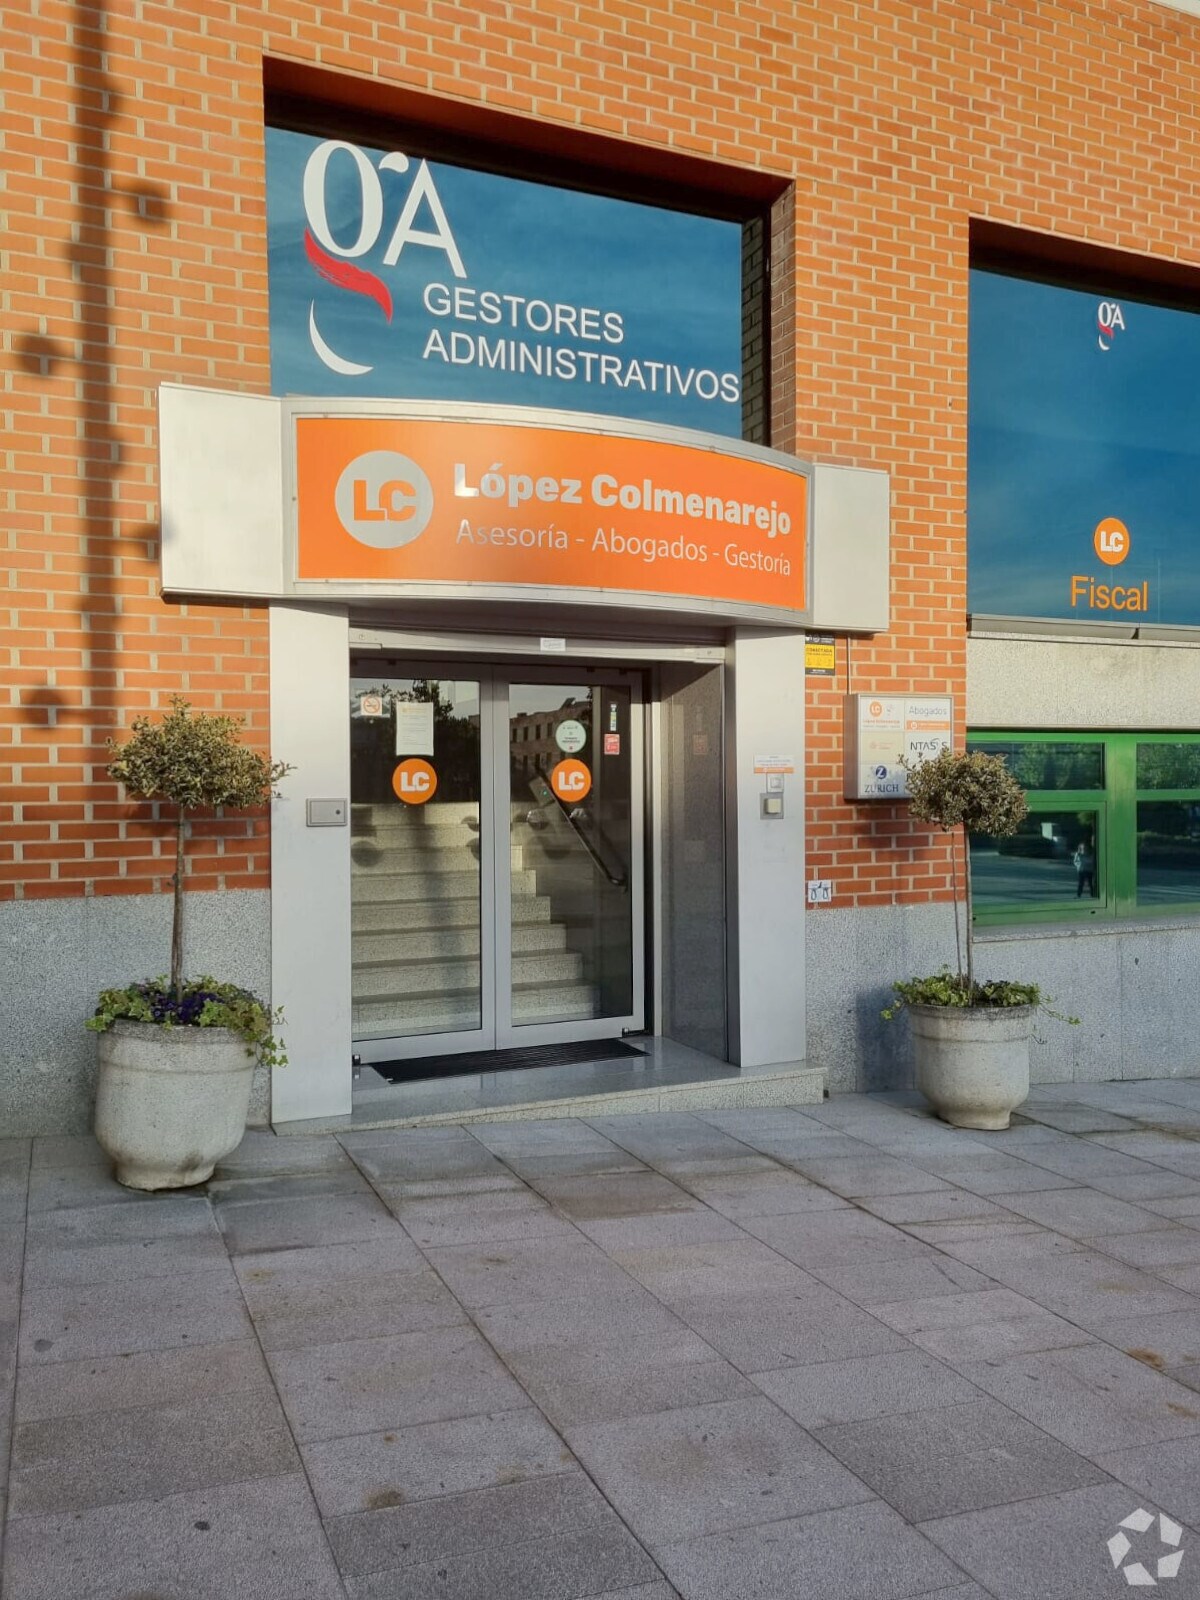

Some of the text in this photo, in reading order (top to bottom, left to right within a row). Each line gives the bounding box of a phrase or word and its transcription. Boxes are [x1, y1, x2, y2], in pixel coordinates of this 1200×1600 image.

[423, 283, 625, 343] GESTORES
[422, 329, 741, 402] ADMINISTRATIVOS
[352, 479, 418, 522] LC
[454, 463, 792, 539] López Colmenarejo
[456, 518, 568, 550] Asesoría
[591, 527, 708, 563] Abogados
[724, 543, 792, 577] Gestoría
[1100, 530, 1124, 552] LC
[1071, 575, 1148, 611] Fiscal
[908, 705, 948, 717] Abogados
[400, 771, 431, 792] LC
[558, 771, 585, 791] LC
[864, 783, 899, 793] ZURICH
